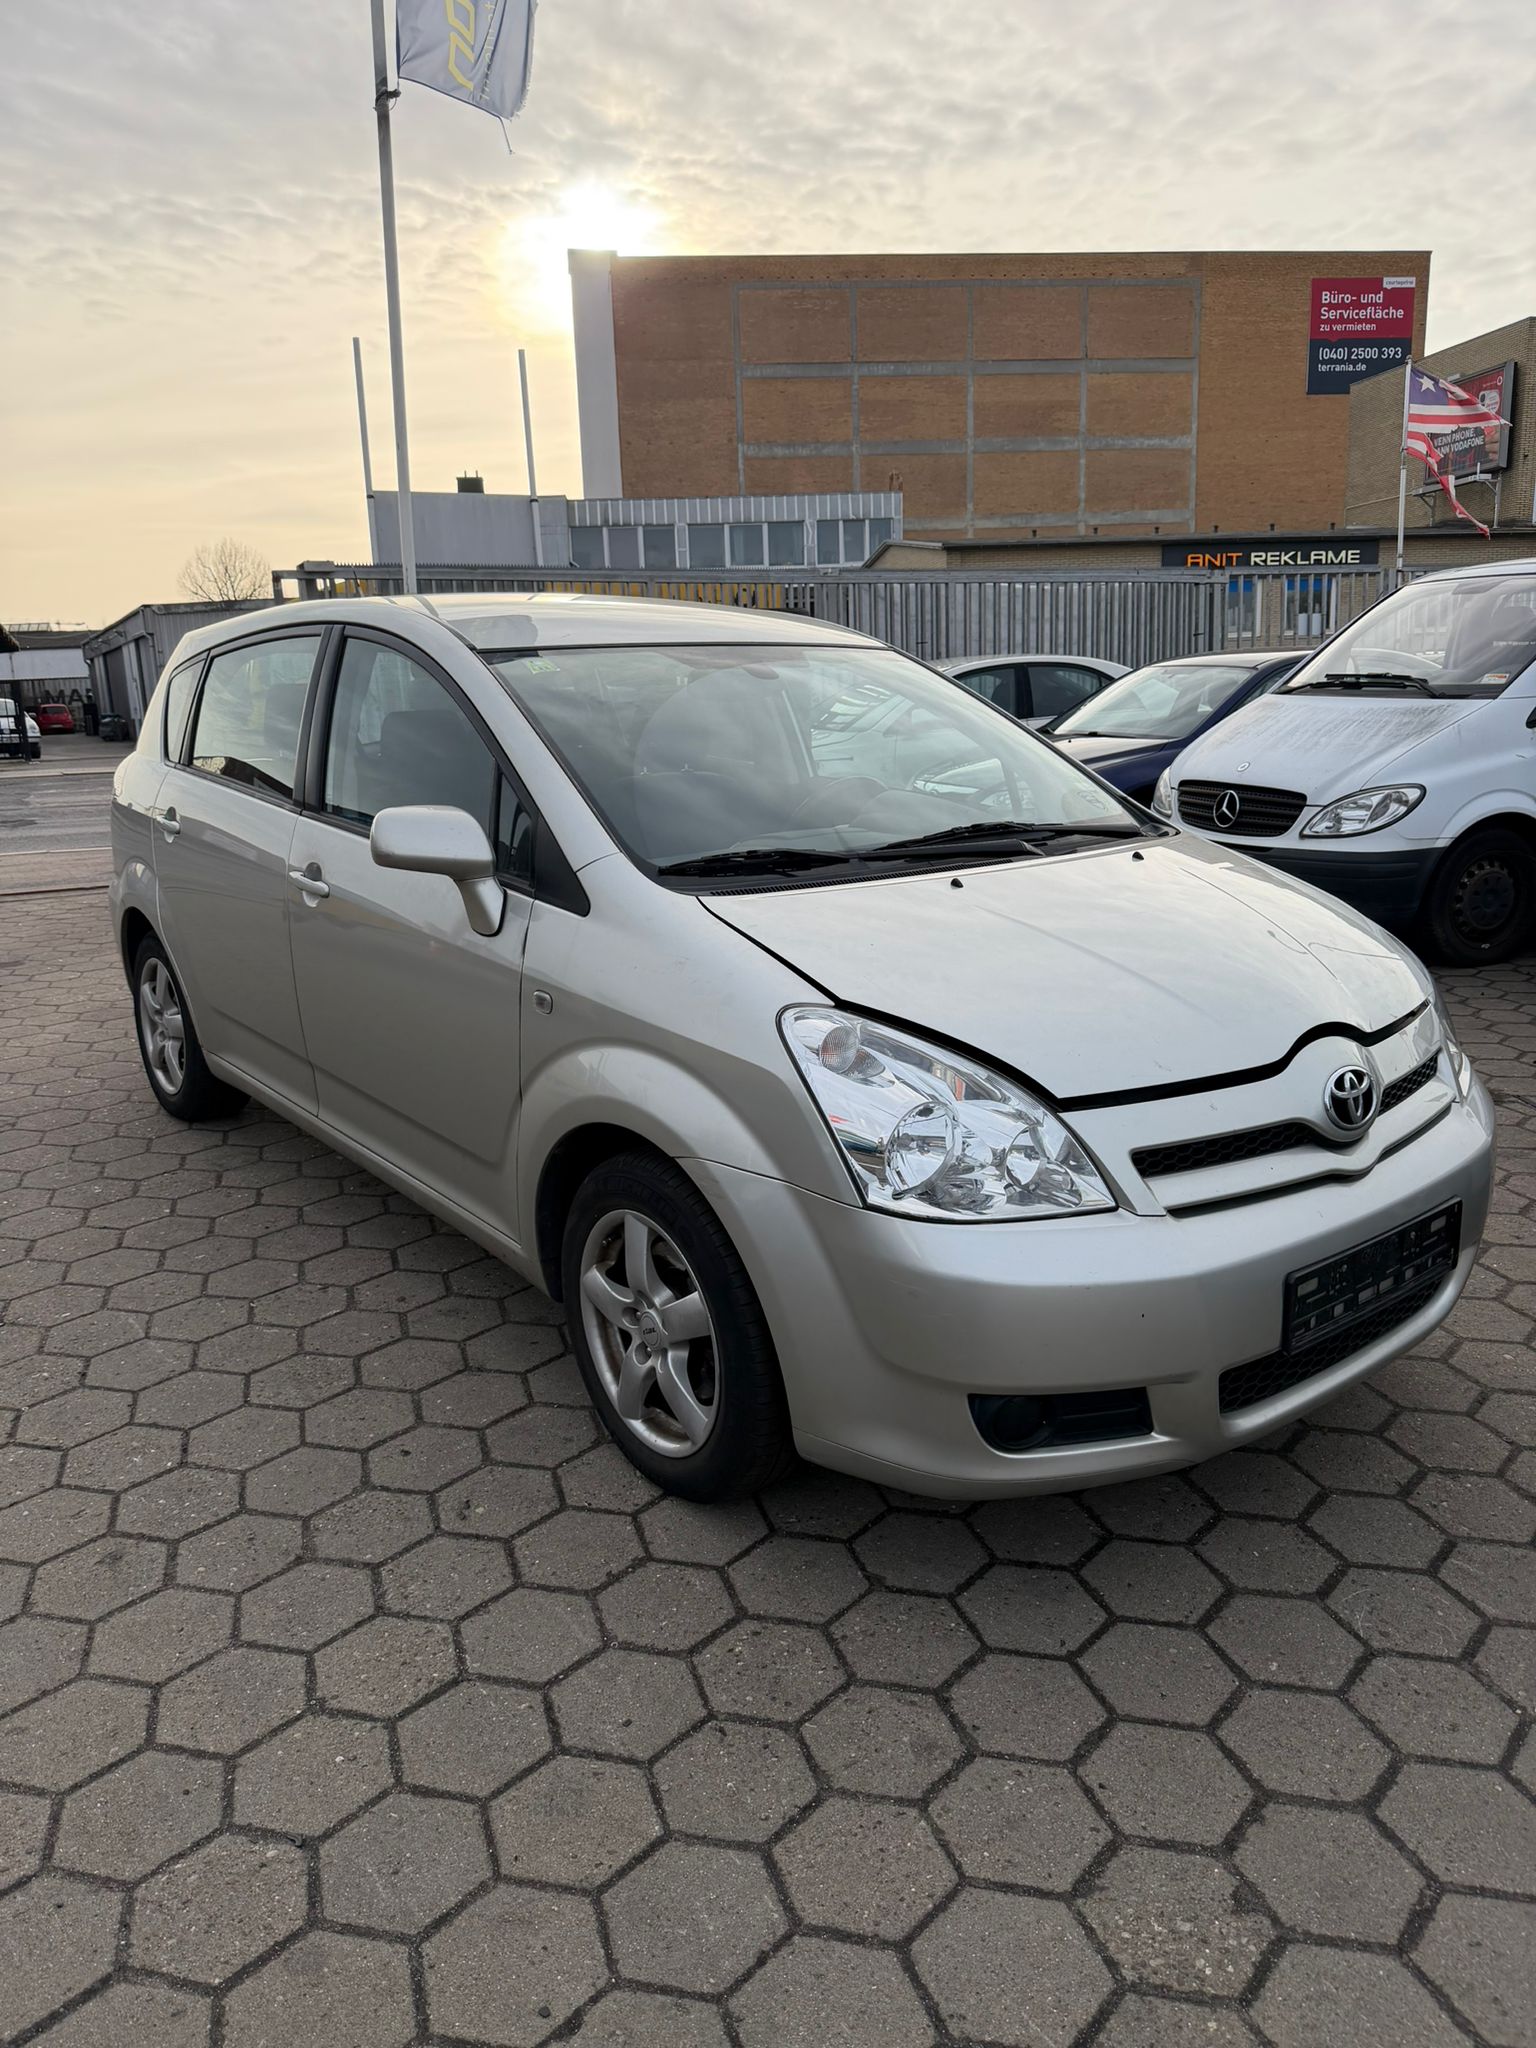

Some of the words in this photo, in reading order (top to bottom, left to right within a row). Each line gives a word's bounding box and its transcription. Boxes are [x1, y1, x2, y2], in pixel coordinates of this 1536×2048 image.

[1321, 291, 1357, 303] Büro-
[1360, 291, 1384, 303] und
[1320, 306, 1404, 319] Servicefläche
[1320, 323, 1330, 331] zu
[1332, 322, 1376, 331] vermieten
[1319, 347, 1348, 360] (040)
[1351, 348, 1378, 359] 2500
[1381, 347, 1402, 359] 393
[1318, 362, 1367, 372] terrania.de
[1186, 552, 1242, 567] ANIT
[1250, 550, 1360, 566] REKLAME
